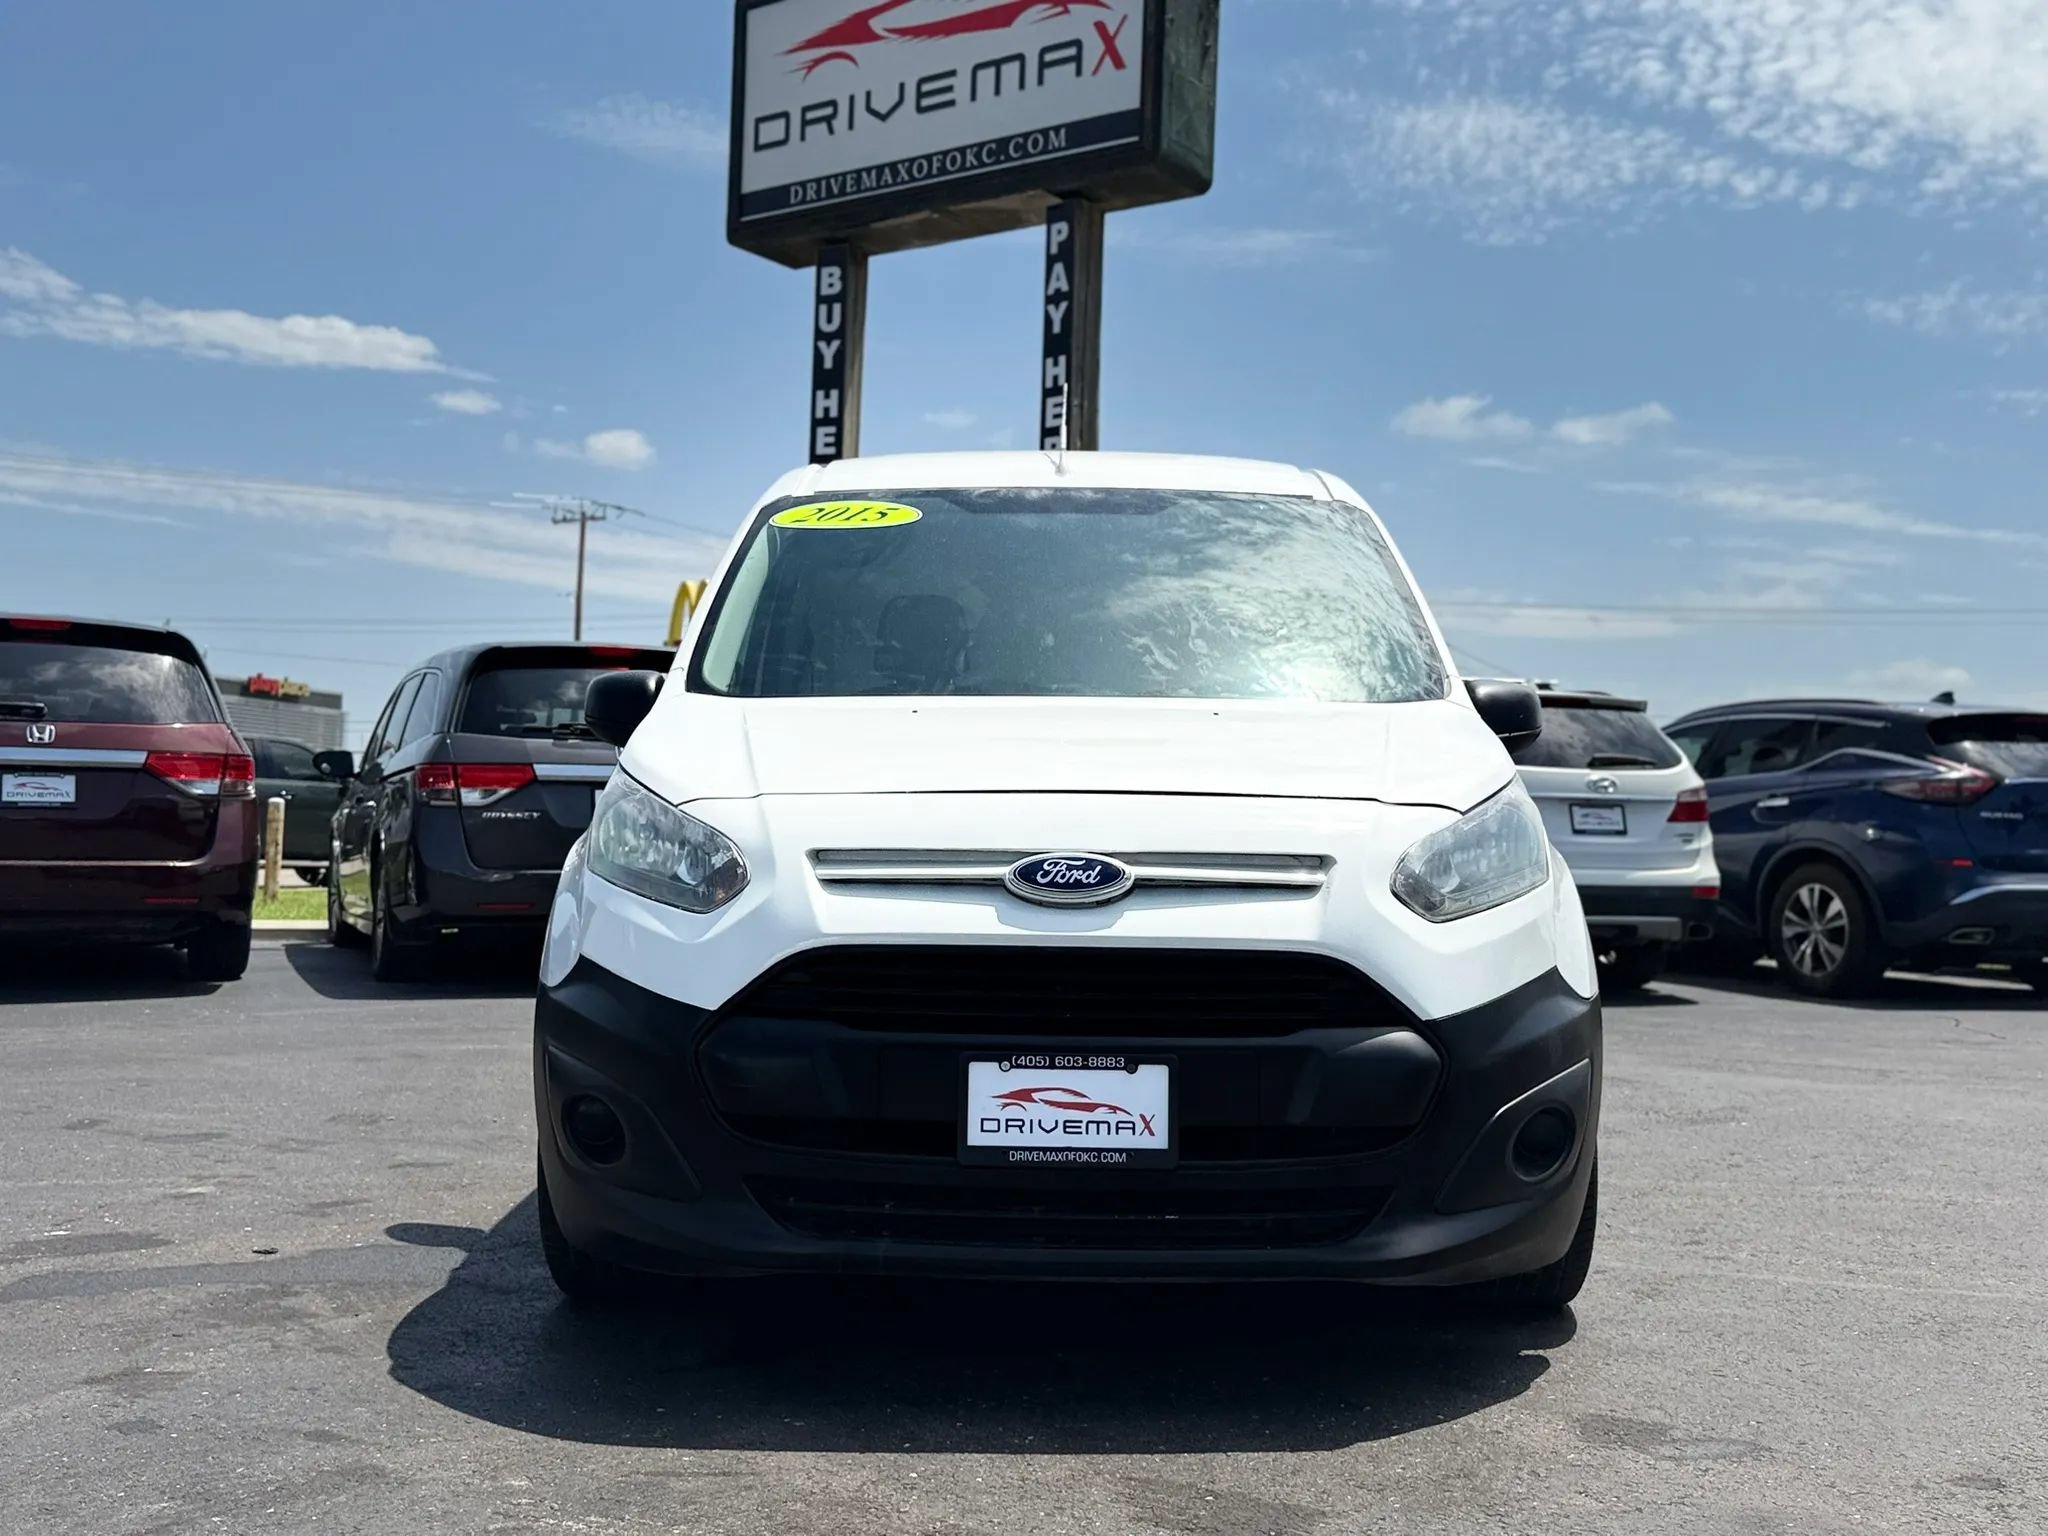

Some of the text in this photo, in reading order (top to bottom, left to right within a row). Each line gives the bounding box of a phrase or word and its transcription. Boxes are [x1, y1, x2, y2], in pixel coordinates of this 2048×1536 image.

[753, 13, 1128, 152] DRIVEMAX
[789, 127, 1068, 204] DRIVEMAXOFOKC.COM
[1046, 220, 1070, 335] PAY
[816, 265, 843, 370] BUY
[789, 506, 901, 523] 2015
[1036, 858, 1102, 884] Ford
[1012, 1055, 1125, 1068] (405) 603-8883
[980, 1113, 1156, 1137] DRIVEMAX
[1009, 1151, 1127, 1163] DRIVEMAXOFOKC.COM
